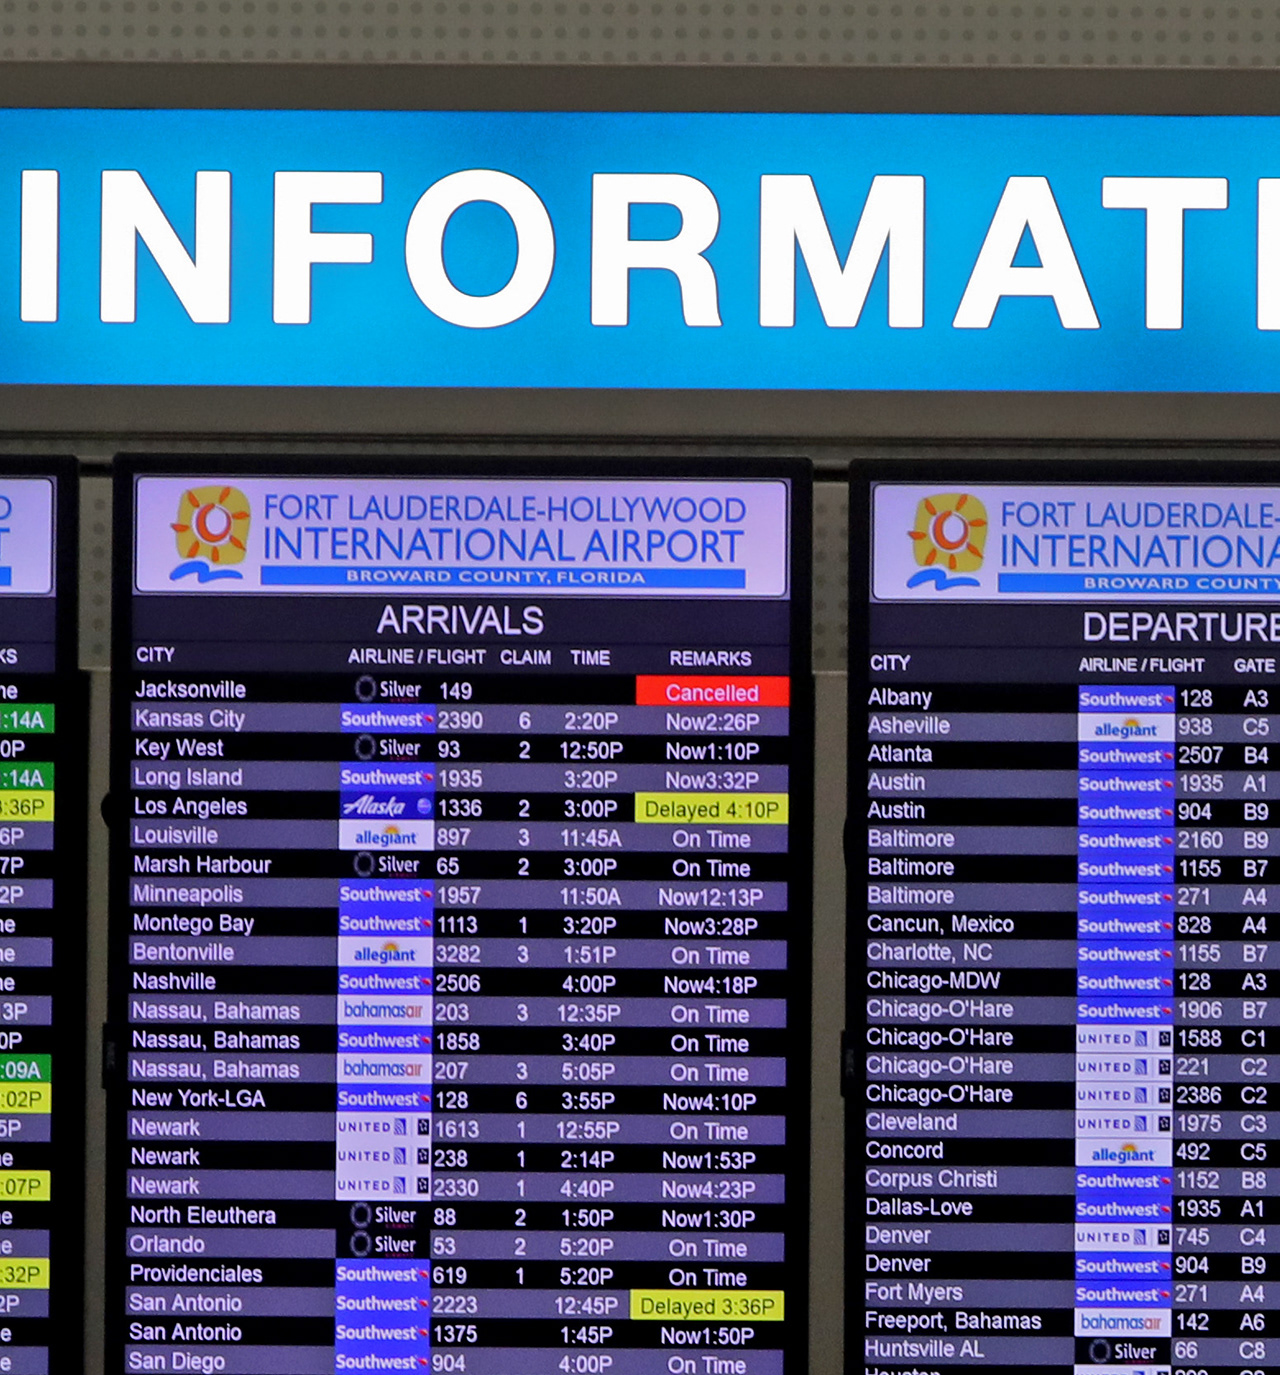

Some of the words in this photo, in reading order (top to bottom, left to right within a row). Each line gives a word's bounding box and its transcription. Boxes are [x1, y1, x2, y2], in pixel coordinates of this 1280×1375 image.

[265, 495, 338, 519] FORT
[349, 495, 745, 522] LAUDERDALE-HOLLYWOOD
[1003, 502, 1075, 527] FORT
[265, 527, 575, 561] INTERNATIONAL
[584, 529, 744, 562] AIRPORT
[344, 569, 454, 584] BROWARD
[459, 571, 550, 584] COUNTY,
[557, 570, 645, 584] FLORIDA
[1081, 577, 1191, 592] BROWARD
[377, 605, 543, 635] ARRIVALS
[869, 655, 910, 670] CITY
[1078, 656, 1139, 674] AIRLINE
[1149, 656, 1206, 674] FLIGHT
[1233, 657, 1277, 675] GATE
[135, 797, 167, 814] Los
[173, 796, 249, 819] Angeles
[341, 795, 406, 817] Alaska
[438, 798, 484, 818] 1336
[519, 800, 529, 817] 2
[565, 800, 617, 817] 3:00P
[646, 801, 719, 822] Delayed
[727, 802, 778, 818] 4:10P
[866, 1141, 943, 1158] Concord
[1093, 1146, 1153, 1163] allegiant
[1175, 1142, 1212, 1162] 492
[1241, 1143, 1266, 1160] C5
[863, 1169, 932, 1192] Corpus
[937, 1169, 997, 1188] Christi
[1075, 1173, 1159, 1189] Southwest
[1179, 1171, 1219, 1188] 1152
[1240, 1171, 1268, 1190] B8
